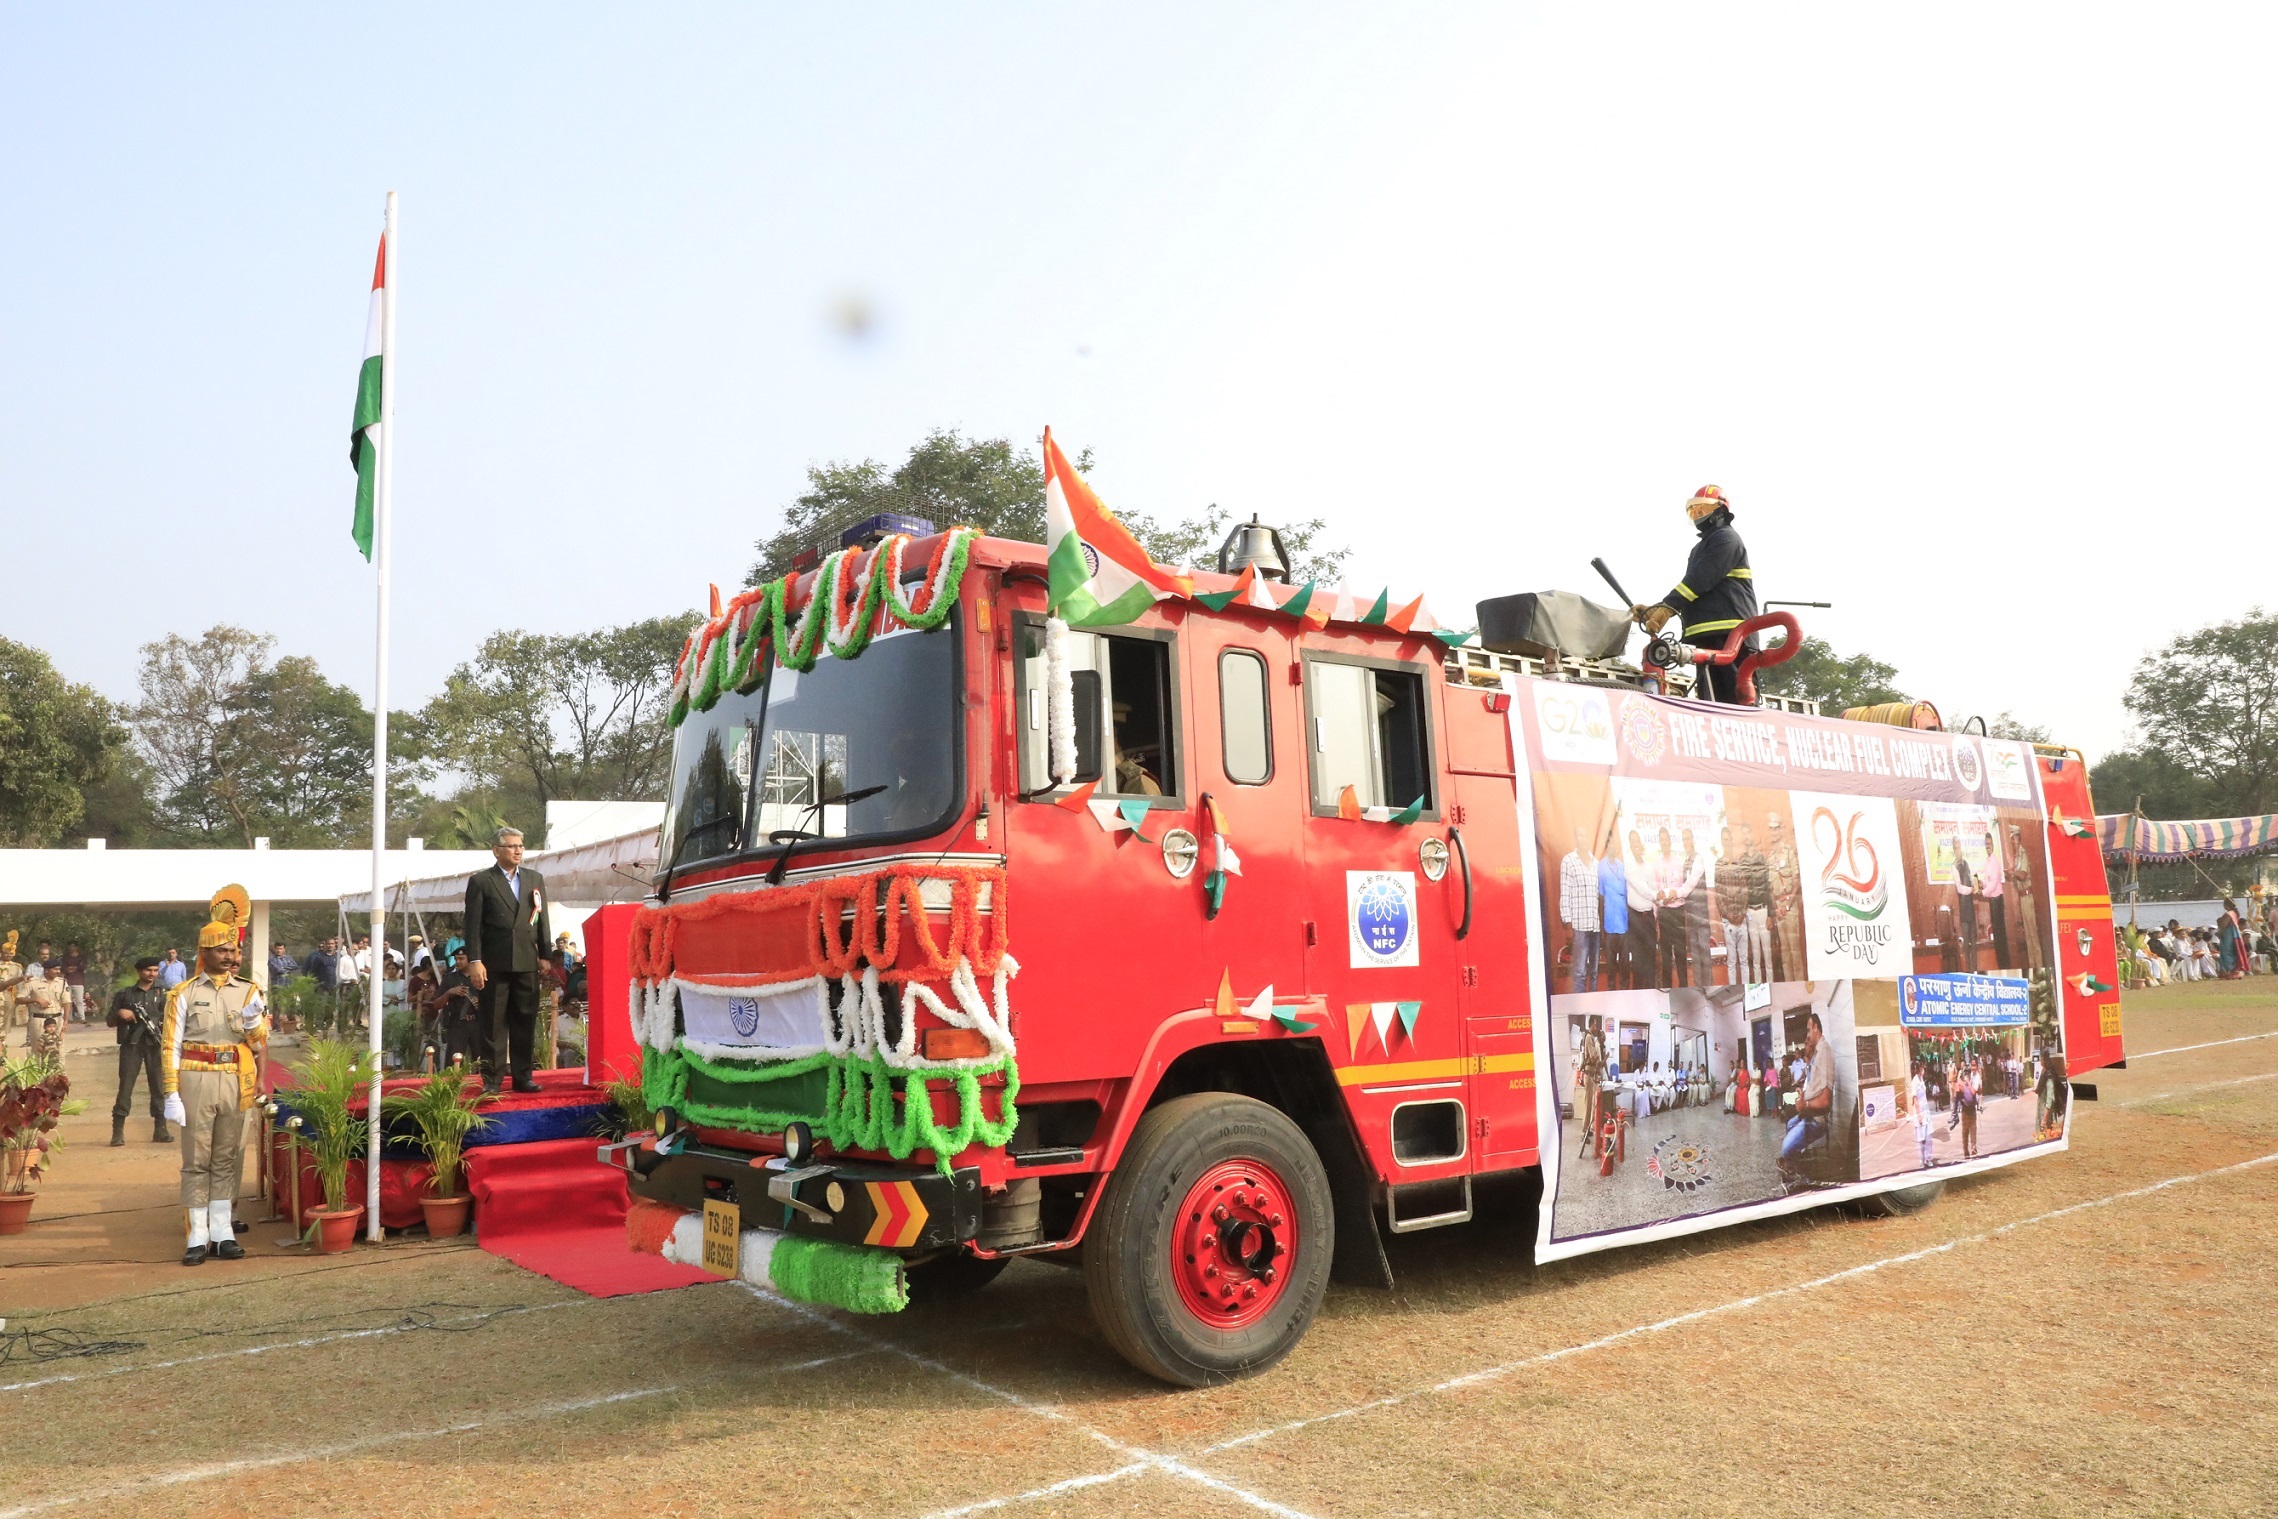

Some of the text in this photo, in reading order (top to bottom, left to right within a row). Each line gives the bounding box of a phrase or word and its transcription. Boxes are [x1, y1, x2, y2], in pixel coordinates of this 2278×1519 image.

[1668, 712, 1952, 781] FIRE SERVICE, NUCLEAR FUEL COMPLEX
[1811, 806, 1879, 893] 26
[1839, 888, 1876, 905] JANUARY
[1827, 914, 1848, 922] HAPPY
[1373, 938, 1396, 949] NFC
[1825, 924, 1892, 954] REPUBLIC
[1853, 944, 1879, 965] DAY
[1919, 978, 1952, 1000] परमाणु
[1921, 1001, 1949, 1014] ATOMIC
[1951, 1002, 1973, 1015] ENERGY
[1508, 1018, 1532, 1030] ACCES
[1509, 1077, 1536, 1090] ACCESS
[708, 1210, 734, 1238] TS 08
[705, 1240, 716, 1265] UG
